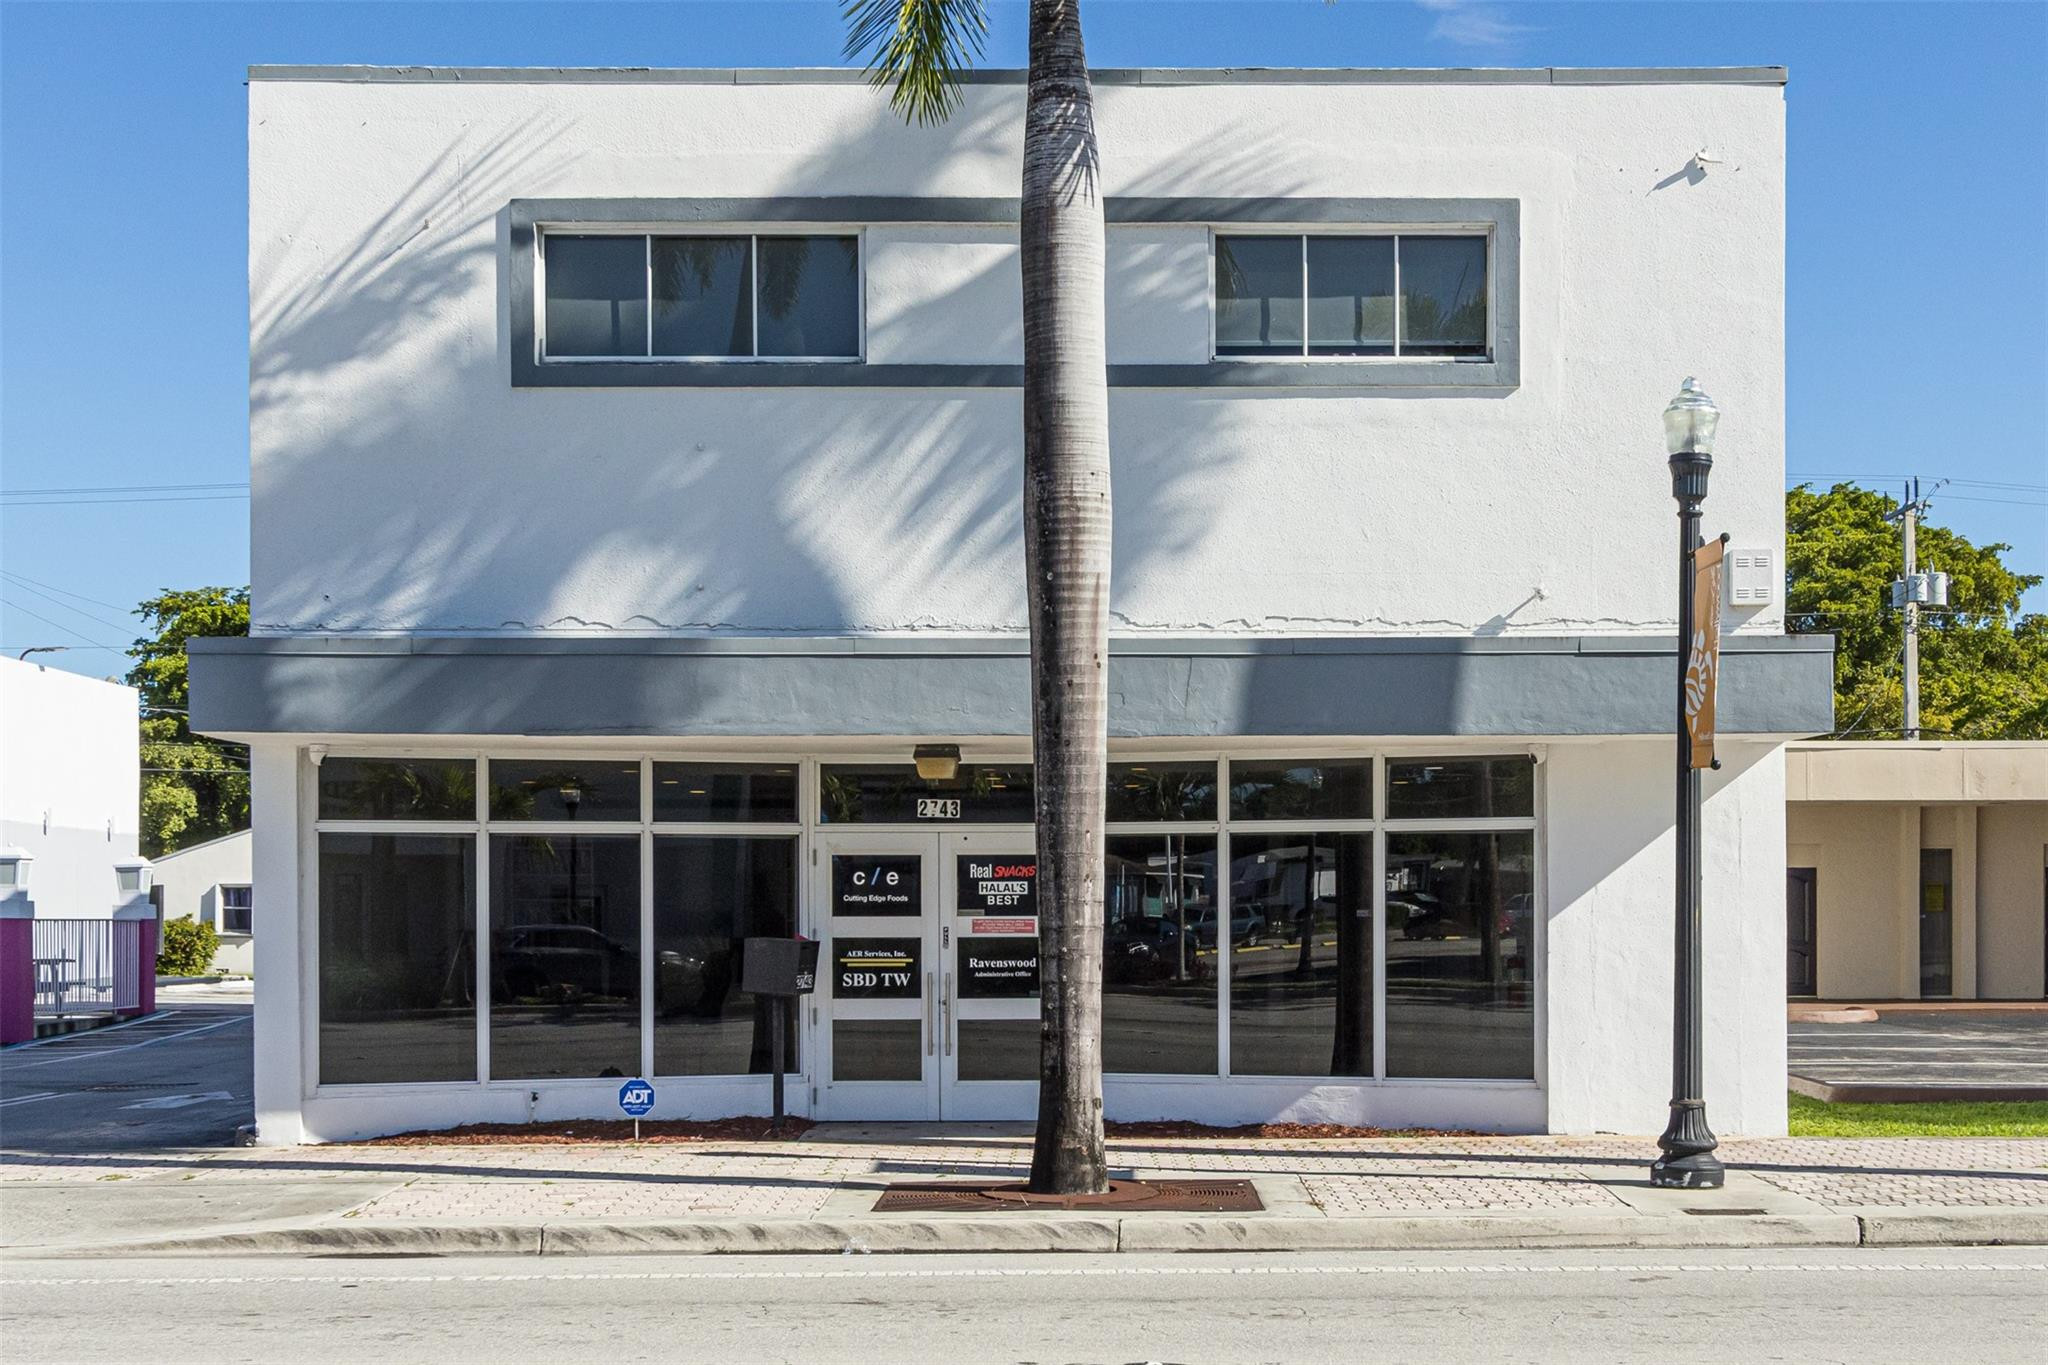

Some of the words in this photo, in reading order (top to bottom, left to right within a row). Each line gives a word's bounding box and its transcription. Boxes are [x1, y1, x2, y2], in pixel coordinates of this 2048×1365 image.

[918, 800, 959, 817] 2743
[969, 863, 993, 879] Real
[994, 865, 1037, 878] SNACKS
[980, 883, 1026, 893] HALAL'S
[843, 894, 868, 903] Cutting
[868, 894, 887, 903] Edge
[887, 894, 909, 902] Foods
[987, 895, 1020, 905] BEST
[864, 950, 893, 958] Services,
[969, 957, 1037, 968] Ravenswood
[842, 972, 878, 987] SBD
[880, 972, 911, 987] TW
[622, 1089, 652, 1104] ADT
